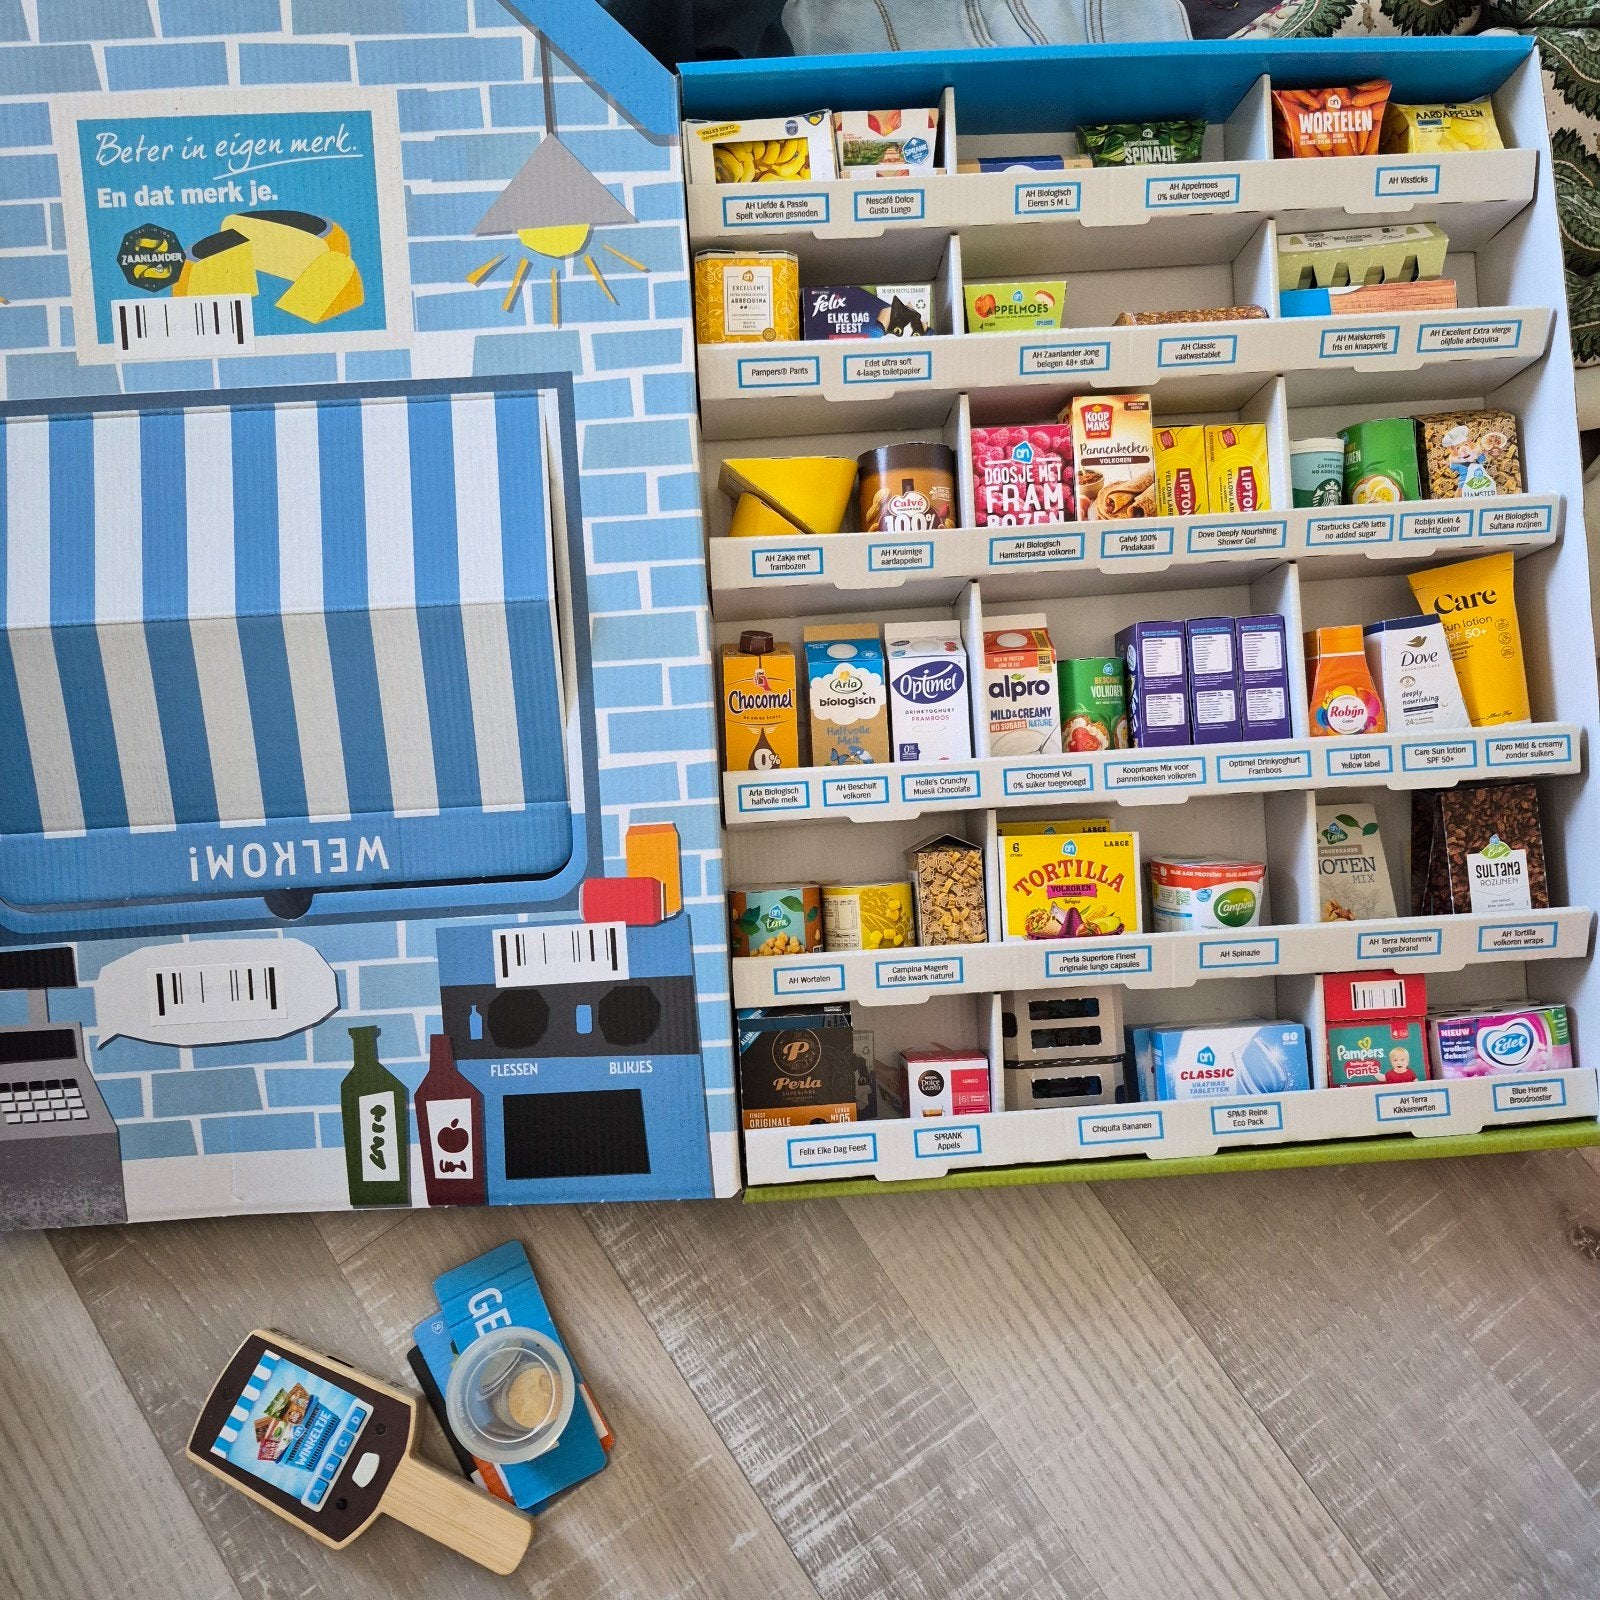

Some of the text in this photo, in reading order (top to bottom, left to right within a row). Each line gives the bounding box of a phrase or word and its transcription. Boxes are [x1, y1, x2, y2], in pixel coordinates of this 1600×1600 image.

[1416, 109, 1483, 120] AARDAPPELEN
[1299, 110, 1372, 133] WORTELEN
[96, 124, 356, 173] Beter in eigen merk.
[1125, 145, 1176, 164] SPINAZIE
[1400, 175, 1428, 184] Vissticks
[1181, 181, 1218, 191] Appelmoes
[97, 181, 278, 208] En dat merk je.
[1158, 190, 1229, 201] 0% suiker toegevoegd
[746, 201, 755, 209] AH
[757, 200, 778, 209] Liefde
[787, 199, 808, 208] Passie
[736, 210, 818, 221] Spelt volkoren gesneden
[122, 253, 183, 265] ZAANLANDER
[812, 294, 846, 317] felix
[987, 304, 1048, 316] APPELMOES
[828, 313, 869, 323] ELKE DAG
[836, 323, 862, 333] FEEST
[790, 367, 808, 375] Pants
[1085, 412, 1109, 422] KOOP
[1086, 421, 1109, 430] MANS
[1080, 443, 1149, 455] Pannenkoeken
[985, 464, 1062, 484] DOOSJE MET
[894, 498, 923, 507] Calvé
[986, 483, 1064, 513] FRAM
[1317, 523, 1350, 531] Starbucks
[1371, 520, 1386, 528] latte
[1119, 534, 1157, 543] Calvé 100%
[1198, 526, 1276, 540] Dove Deeply Nourishing
[1335, 531, 1356, 539] added
[1358, 530, 1376, 540] sugar
[1218, 537, 1255, 545] Shower Gel
[1121, 543, 1154, 552] Pindakaas
[1434, 590, 1497, 614] Care
[1463, 616, 1492, 627] lotion
[1465, 628, 1487, 638] 50+
[1401, 651, 1437, 666] Dove
[835, 680, 857, 689] Arla
[900, 664, 957, 700] Optimel
[989, 675, 1049, 702] alpro
[1091, 685, 1123, 697] VOLKOREN
[1402, 690, 1422, 698] deeply
[729, 689, 793, 714] Chocomel
[819, 695, 875, 707] biologisch
[1403, 695, 1439, 705] nourishing
[1330, 706, 1364, 718] Robijn
[1001, 721, 1025, 729] SUGARS
[1029, 719, 1052, 727] NATURE
[1414, 748, 1430, 756] Care
[1446, 745, 1466, 754] lotion
[754, 749, 781, 770] 0%
[1350, 752, 1370, 761] Lipton
[1427, 756, 1440, 764] SPF
[1341, 760, 1380, 769] Yellow label
[915, 776, 968, 787] Holle's Crunchy
[914, 784, 970, 795] Muesli Chocolate
[1013, 843, 1019, 852] 6
[190, 836, 390, 881] WELKOM!
[1013, 859, 1126, 896] TORTILLA
[1353, 874, 1375, 883] MIX
[1480, 877, 1518, 886] ROZIJNEN
[1218, 900, 1254, 916] Campina
[1232, 948, 1260, 958] Spinazie
[1282, 1032, 1298, 1041] 60
[1441, 1029, 1469, 1037] NIEUW
[1495, 1036, 1525, 1054] Edet
[1337, 1046, 1384, 1060] Pampers
[490, 1062, 538, 1077] FLESSEN
[609, 1061, 652, 1075] BLIKJES
[1346, 1065, 1379, 1077] pants
[1181, 1068, 1234, 1080] CLASSIC
[773, 1077, 822, 1090] Perla
[1512, 1085, 1547, 1094] Blue Home
[1510, 1093, 1551, 1103] Broodrooster
[750, 1117, 791, 1128] ORIGINALE
[935, 1132, 962, 1140] SPRANK
[800, 1144, 866, 1155] Felix Elke Dag Feest
[938, 1141, 960, 1150] Appels
[296, 1410, 331, 1466] WINKELTJE
[312, 1489, 322, 1498] A
